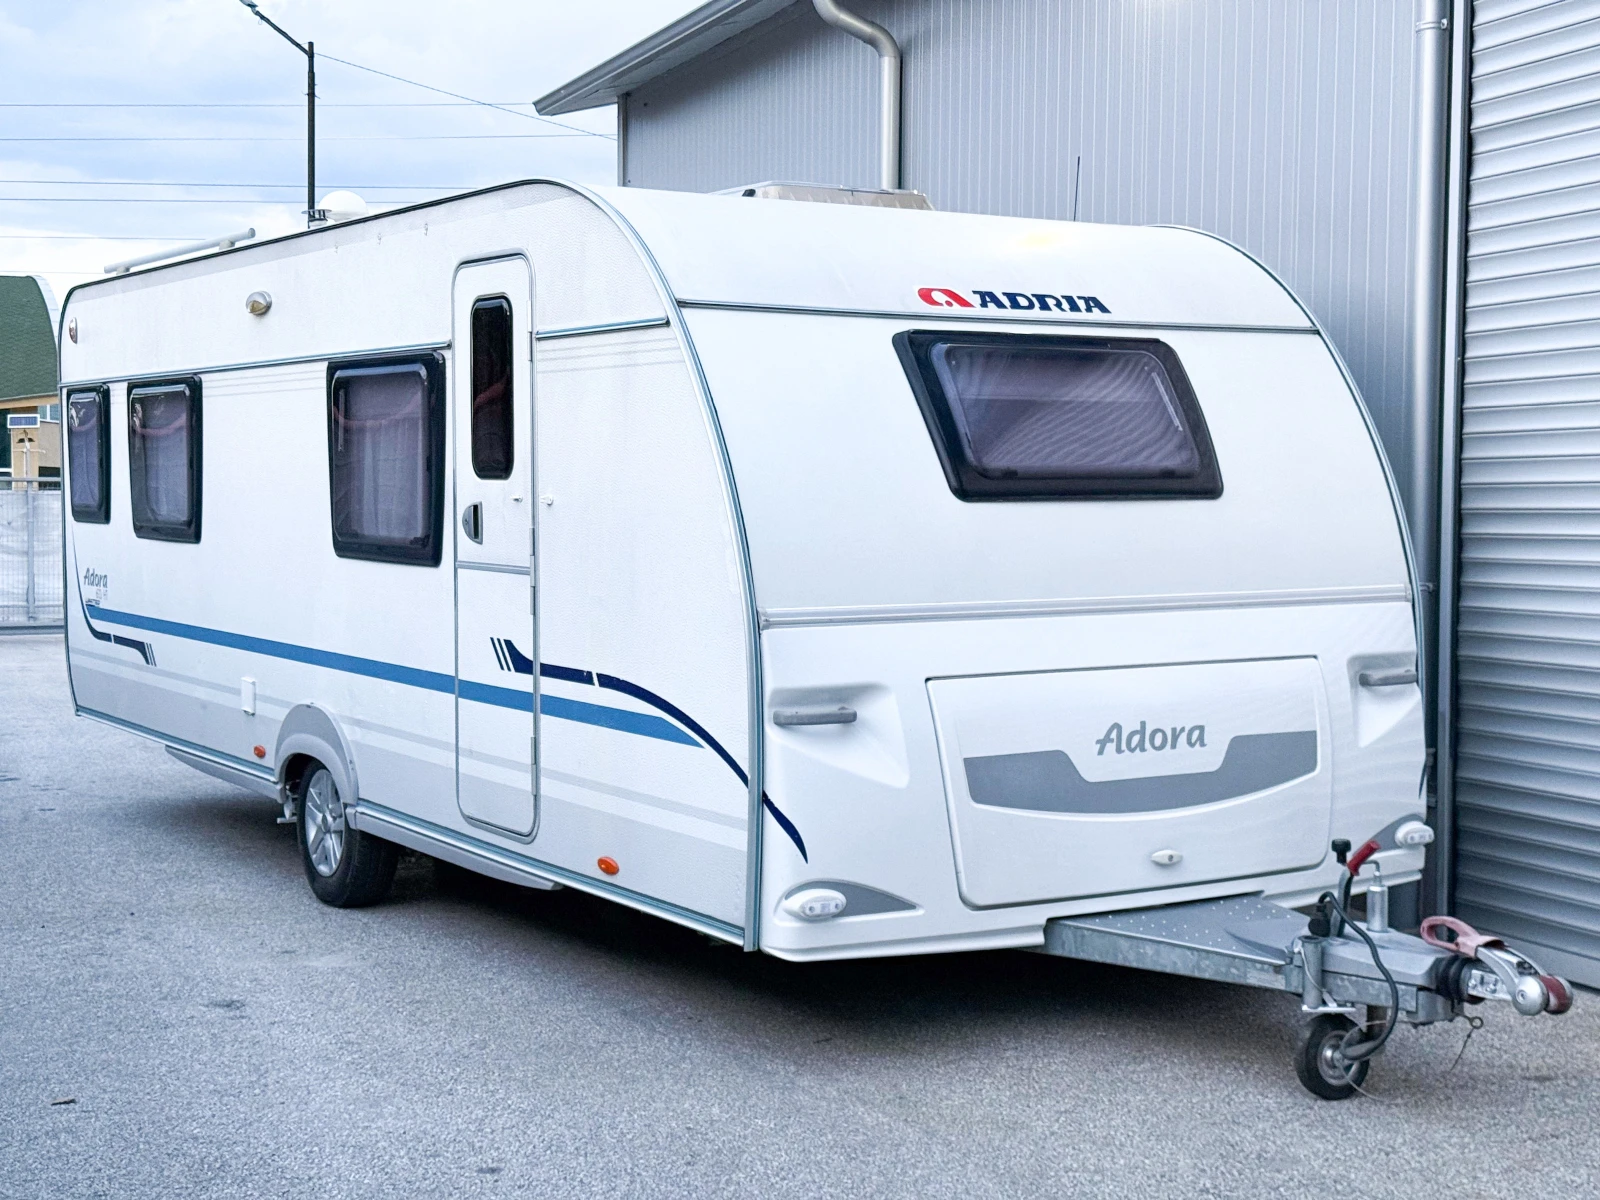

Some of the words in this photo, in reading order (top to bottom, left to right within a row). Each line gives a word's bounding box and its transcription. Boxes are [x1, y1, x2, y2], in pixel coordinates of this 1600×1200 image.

[972, 290, 1112, 314] ADRIA
[83, 567, 108, 588] Adora
[1095, 720, 1207, 756] Adora
